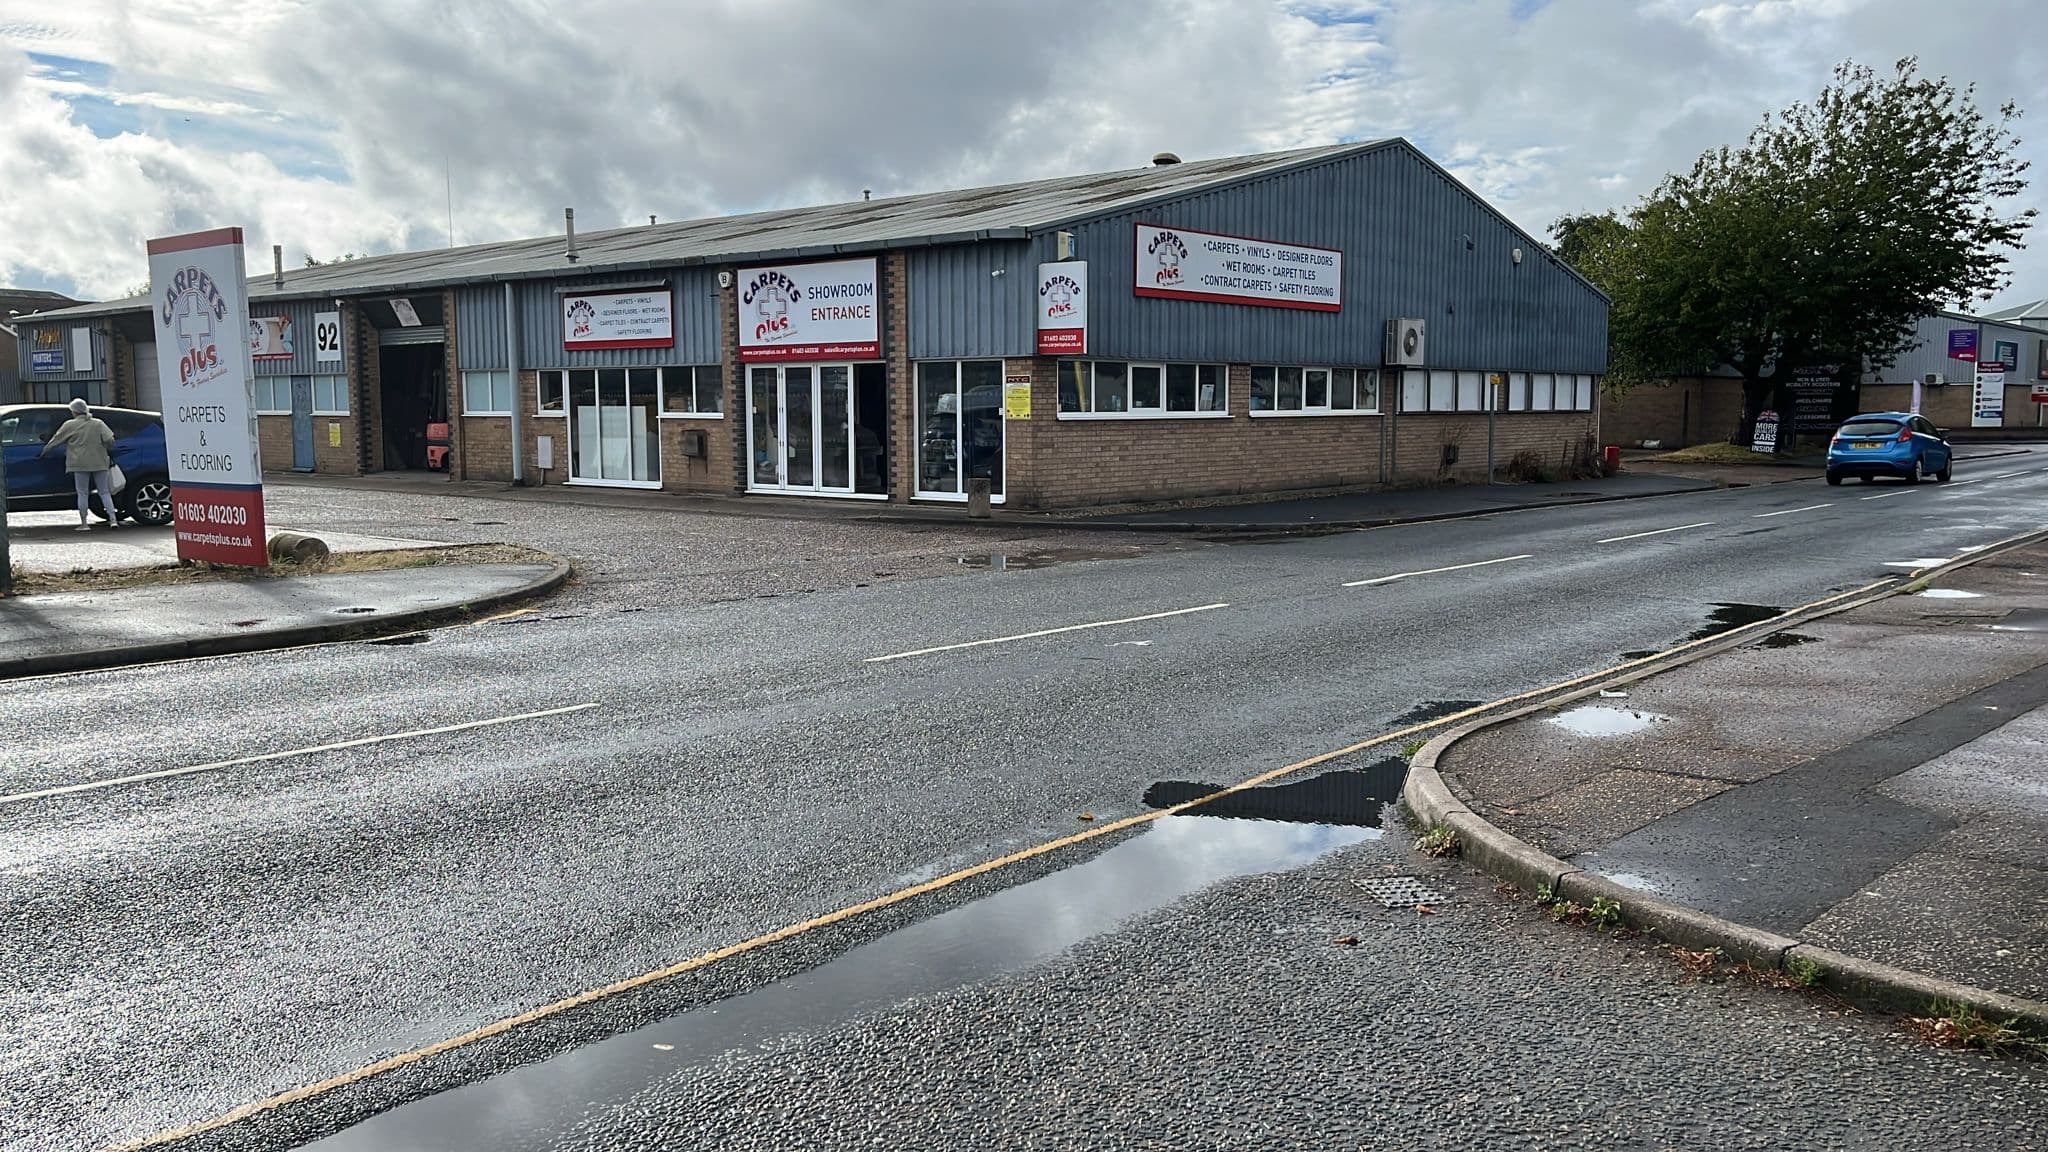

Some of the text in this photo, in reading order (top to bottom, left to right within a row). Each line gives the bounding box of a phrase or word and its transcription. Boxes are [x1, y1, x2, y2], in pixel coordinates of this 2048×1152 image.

[1148, 231, 1188, 259] CARPETS
[1208, 241, 1333, 266] CARPETS VINYLS DESIGNER FLOORS
[1156, 268, 1178, 283] plus
[1226, 260, 1316, 280] WET ROOMS CARPET TILES
[744, 272, 802, 304] CARPETS
[808, 282, 873, 300] SHOWROOM
[1040, 275, 1081, 296] CARPETS
[1204, 275, 1334, 296] CONTRACT CARPETS SAFETY FLOORING
[163, 267, 227, 326] CARPETS
[566, 300, 596, 318] CARPETS
[812, 305, 870, 320] ENTRANCE
[1048, 304, 1071, 317] plus
[318, 322, 338, 351] 92
[574, 325, 590, 336] plus
[756, 316, 788, 340] plus
[180, 345, 218, 384] plus
[178, 406, 226, 422] CARPETS
[1756, 423, 1778, 431] MORE
[200, 430, 207, 446] &
[181, 454, 232, 472] FLOORING
[178, 502, 247, 525] 01603 402030
[178, 531, 252, 547] www.carpetsplus.co.uk
